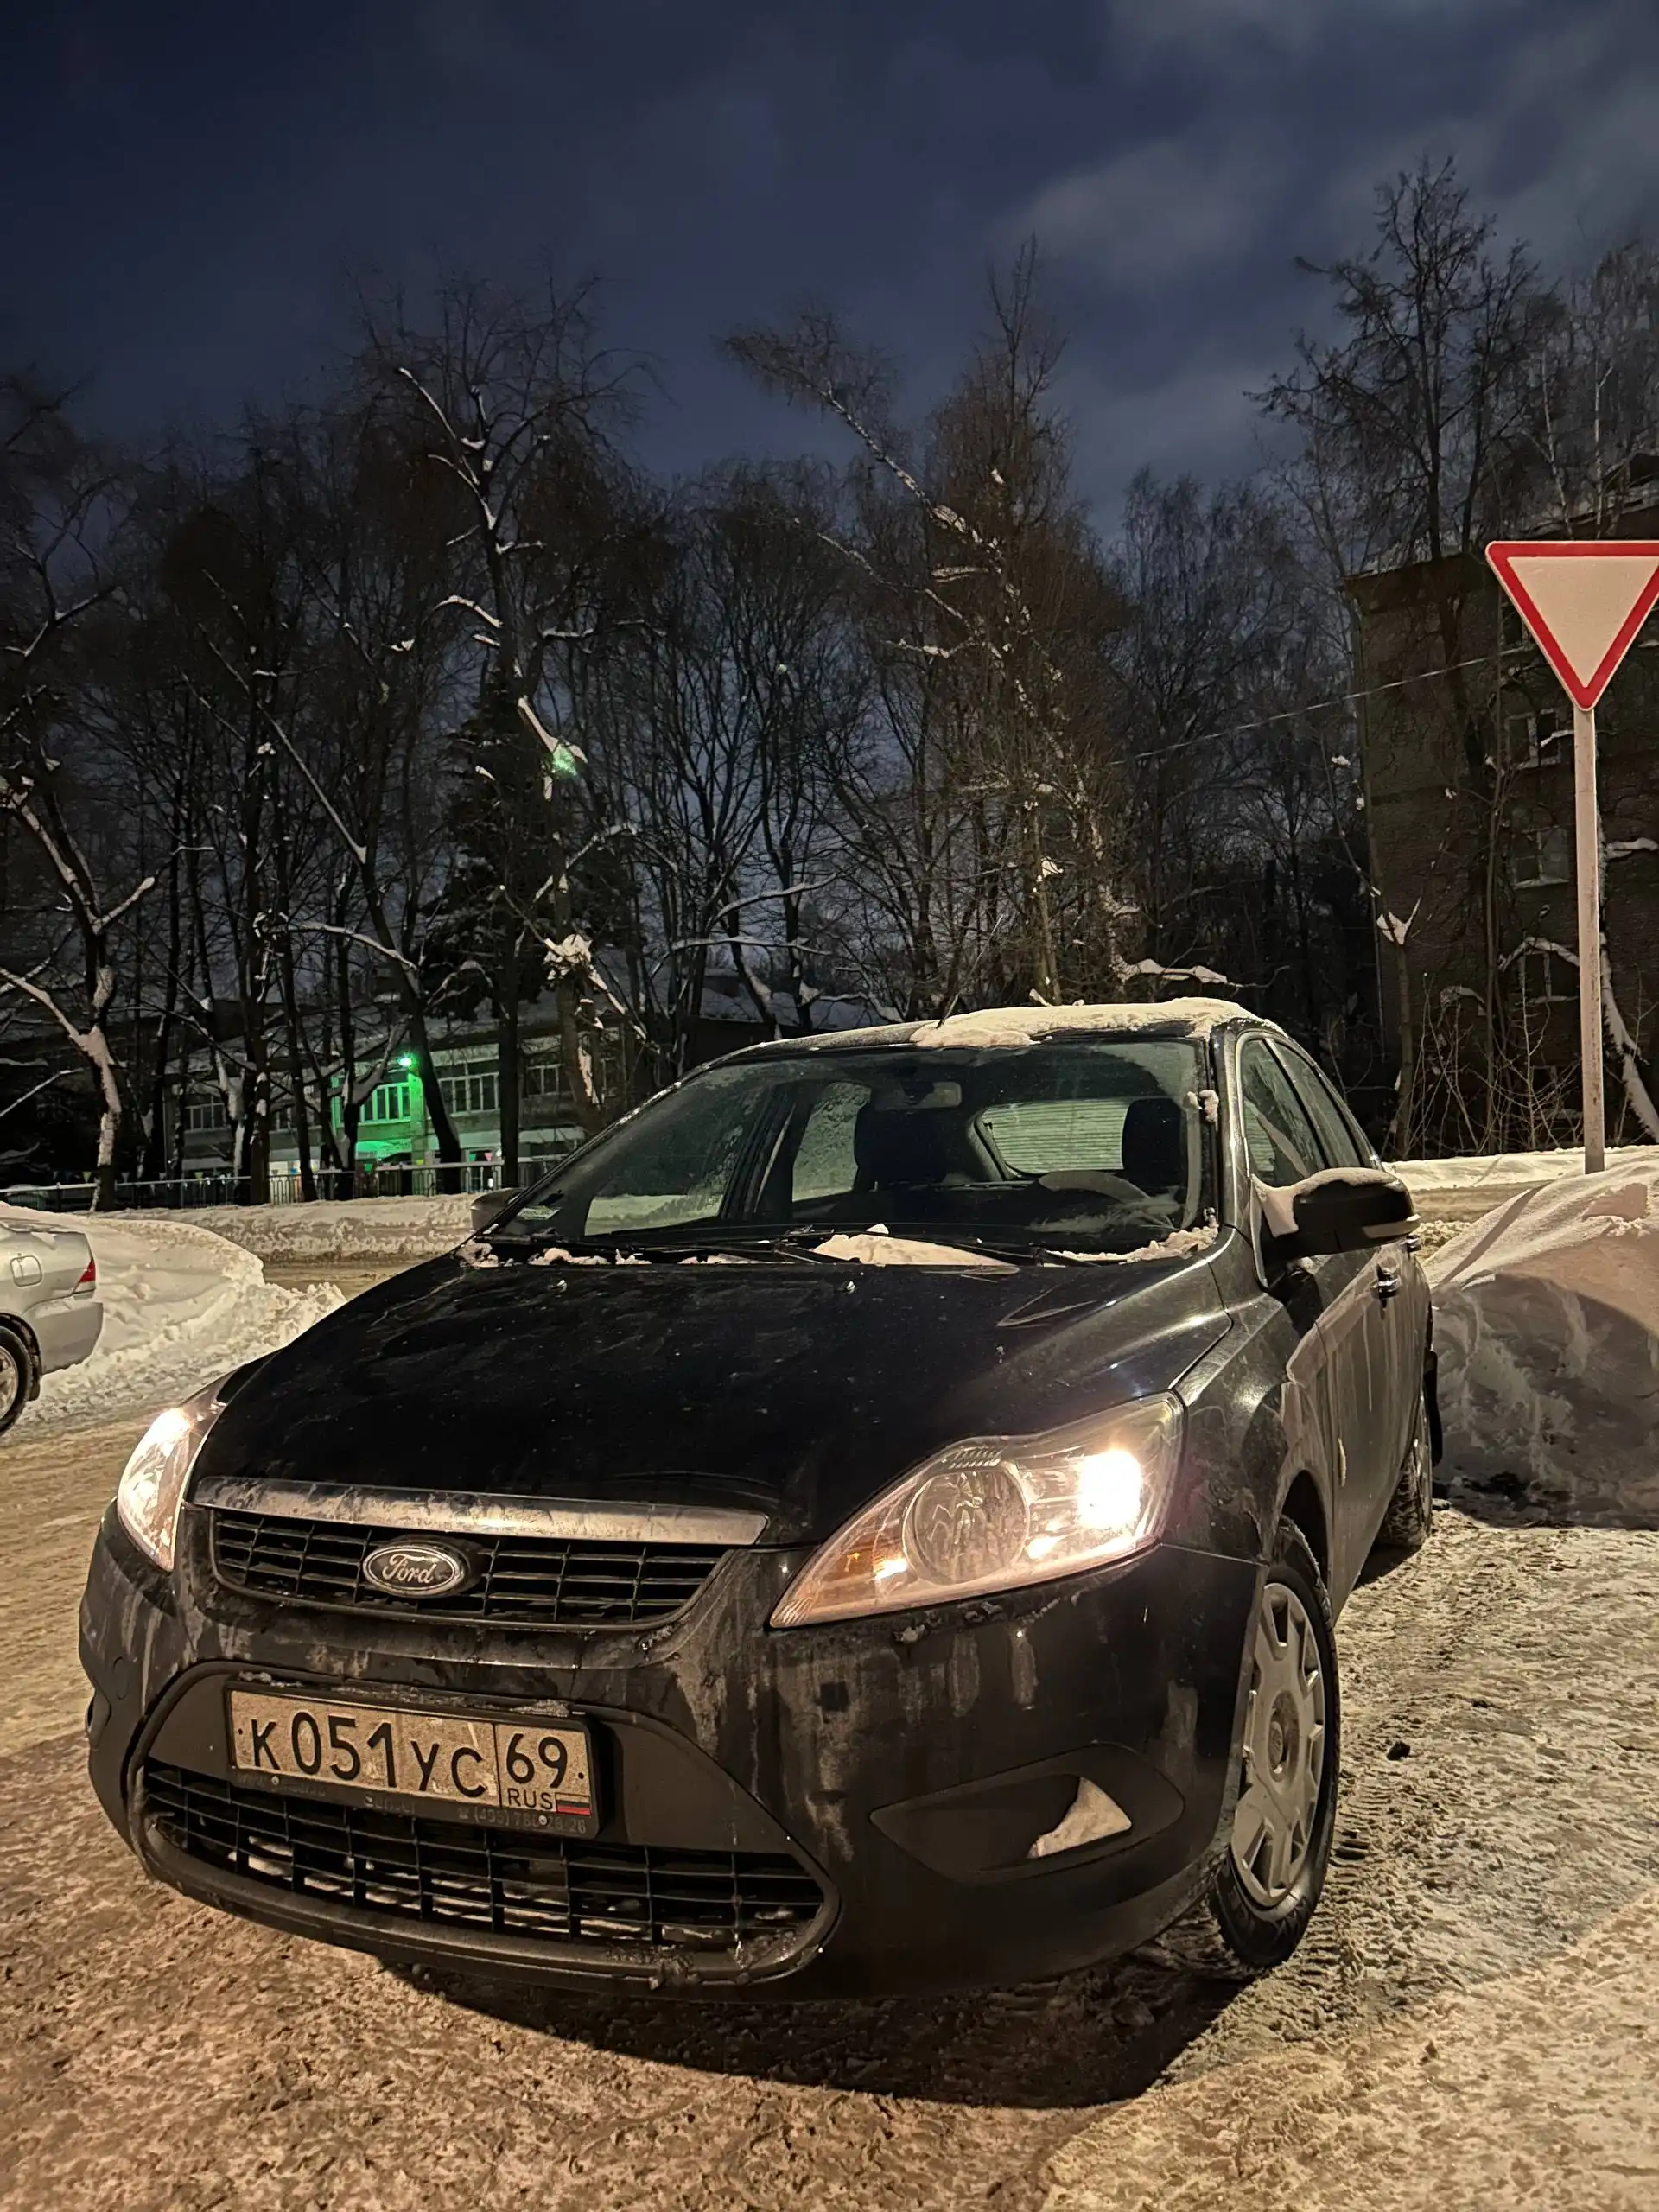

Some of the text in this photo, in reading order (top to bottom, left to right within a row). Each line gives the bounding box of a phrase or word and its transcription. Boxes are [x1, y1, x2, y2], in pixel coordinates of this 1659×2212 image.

[382, 1553, 440, 1583] Ford
[505, 1733, 568, 1789] 69
[507, 1787, 553, 1810] RUS
